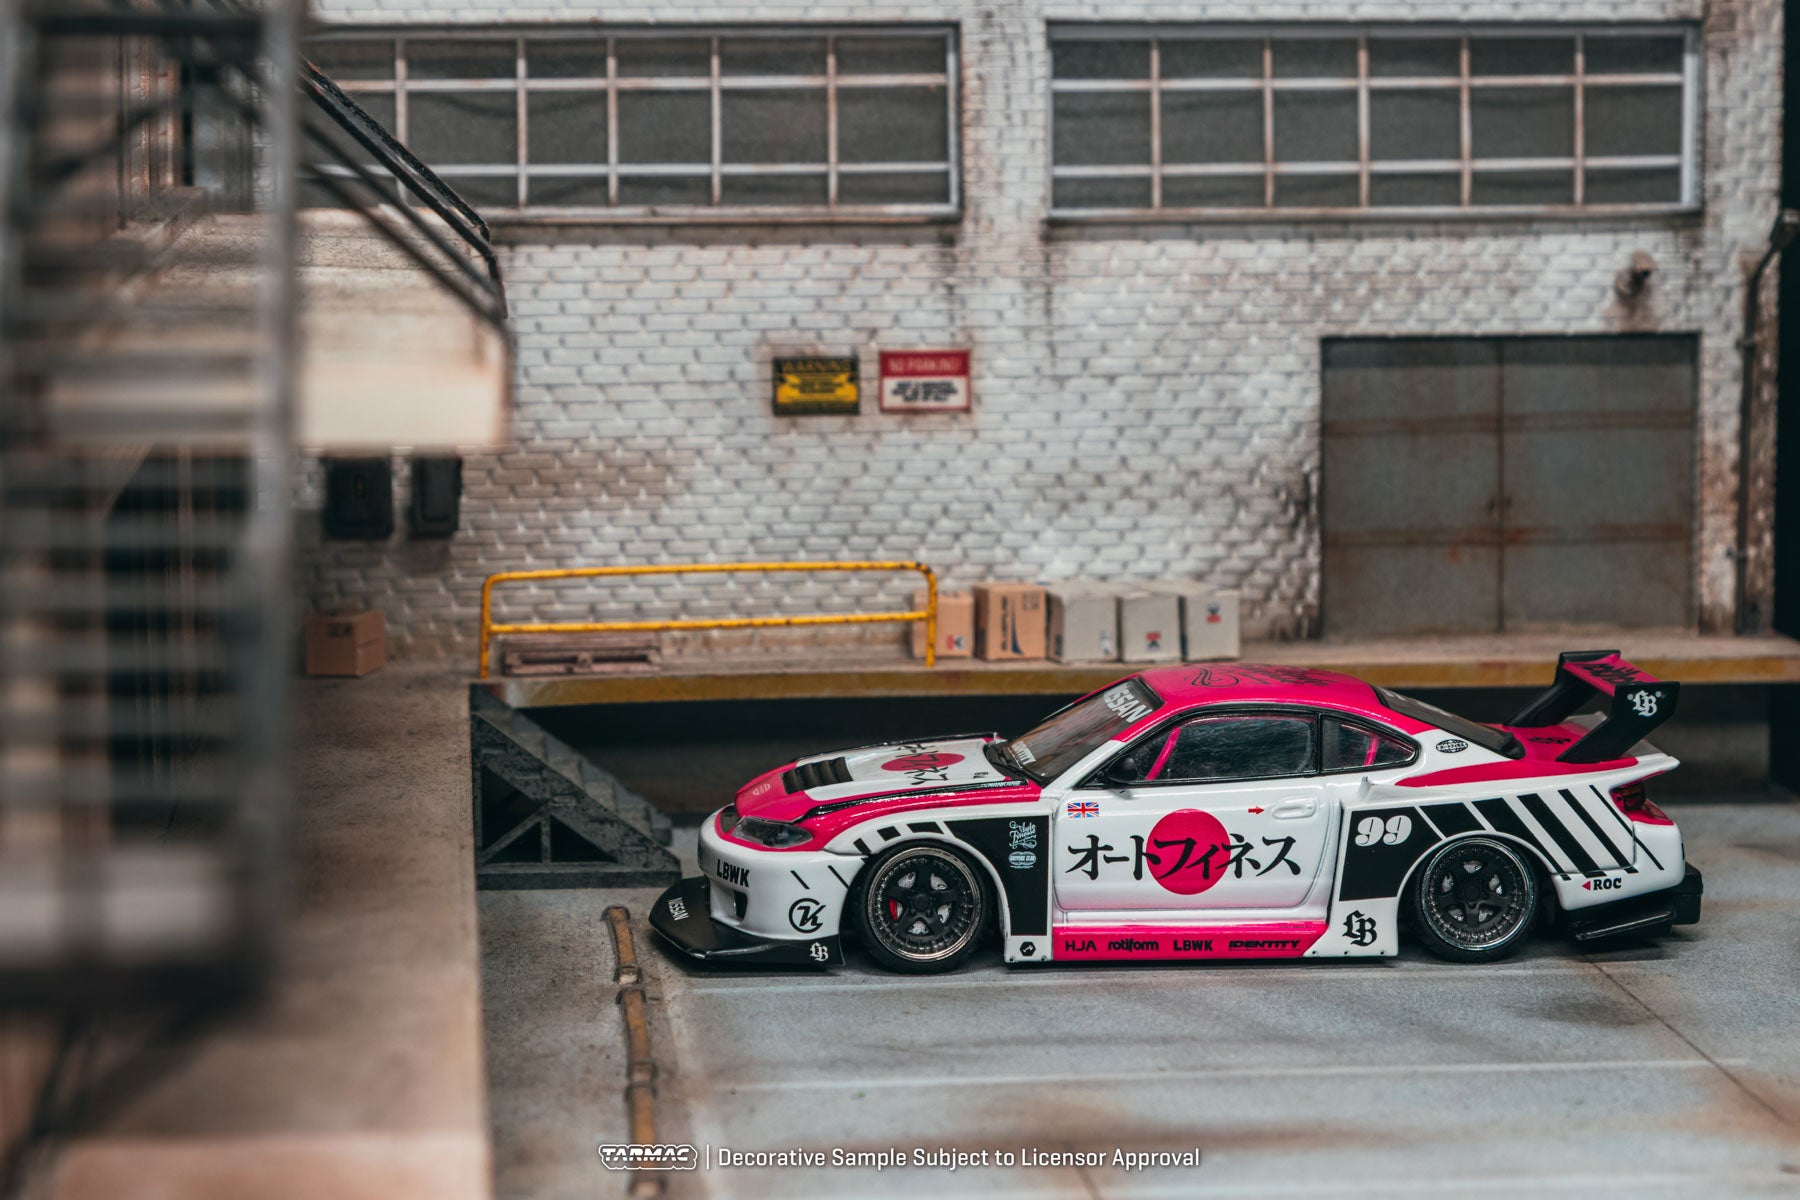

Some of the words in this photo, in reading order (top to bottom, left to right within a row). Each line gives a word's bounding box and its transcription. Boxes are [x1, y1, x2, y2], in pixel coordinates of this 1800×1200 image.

[1354, 815, 1412, 847] 99
[1065, 833, 1301, 881] オートフィネス
[716, 859, 750, 888] LBWK
[1593, 877, 1622, 890] ROC
[1065, 940, 1097, 952] HJA
[1108, 938, 1159, 953] rotiform
[1173, 940, 1214, 951] LBWK
[1228, 939, 1300, 950] IDENTITY
